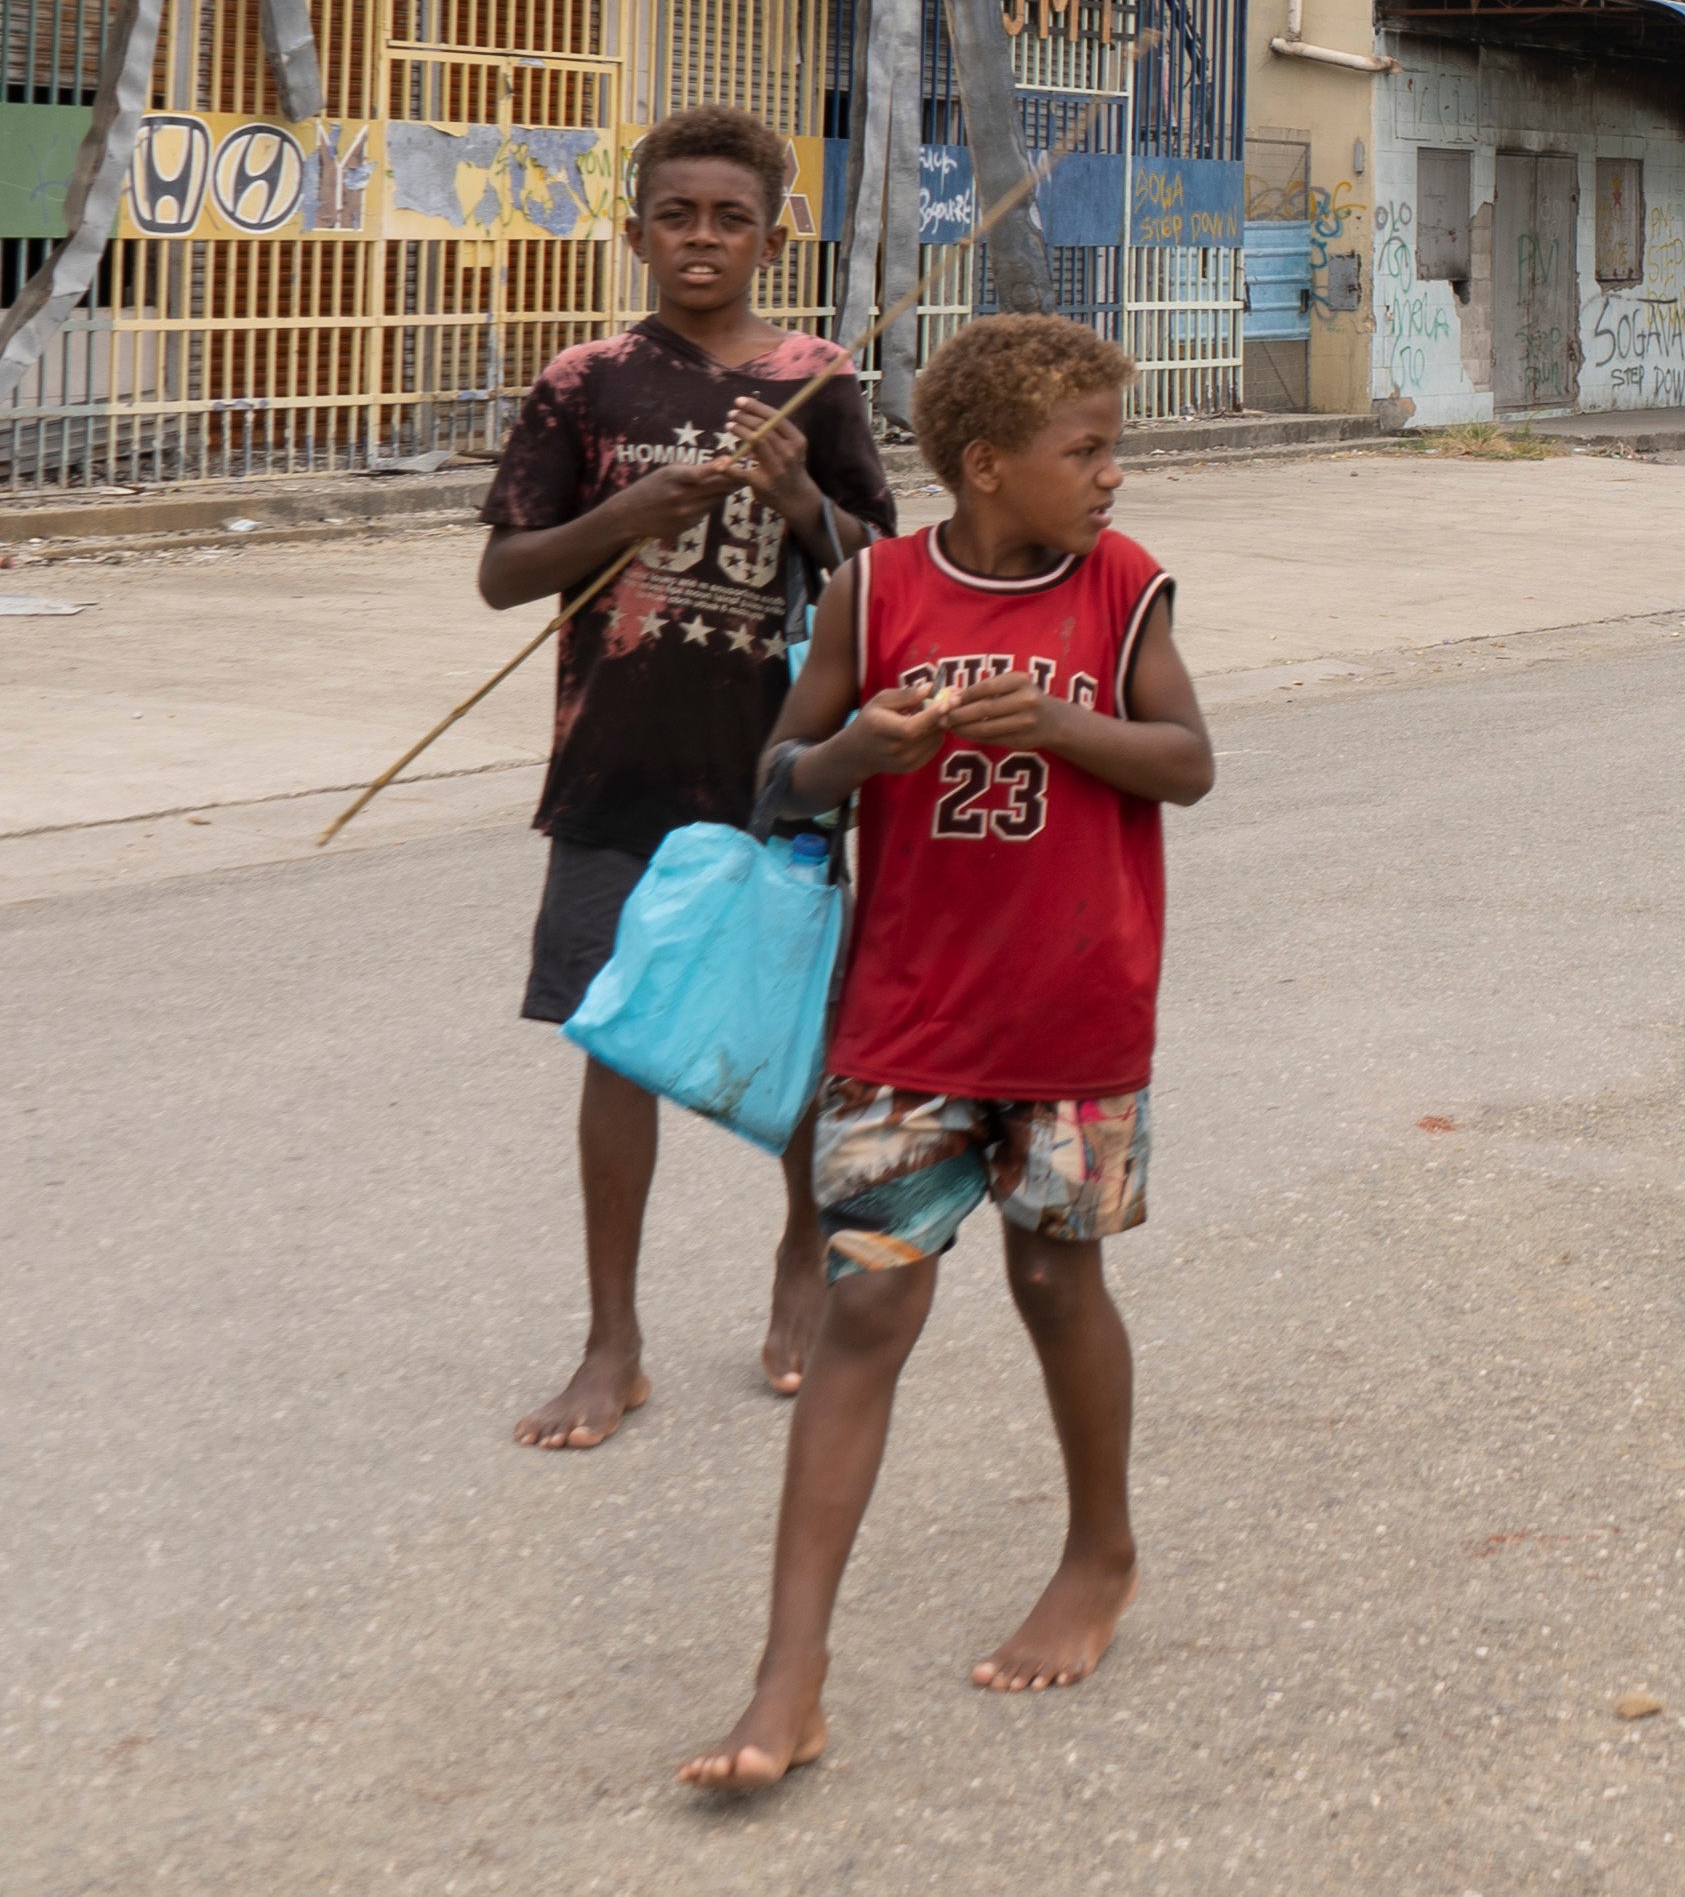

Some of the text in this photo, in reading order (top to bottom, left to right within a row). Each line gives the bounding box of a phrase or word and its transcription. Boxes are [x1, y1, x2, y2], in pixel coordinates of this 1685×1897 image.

[1139, 203, 1238, 246] STEP DOWN
[1611, 366, 1645, 397] STEP
[931, 750, 1049, 841] 23
